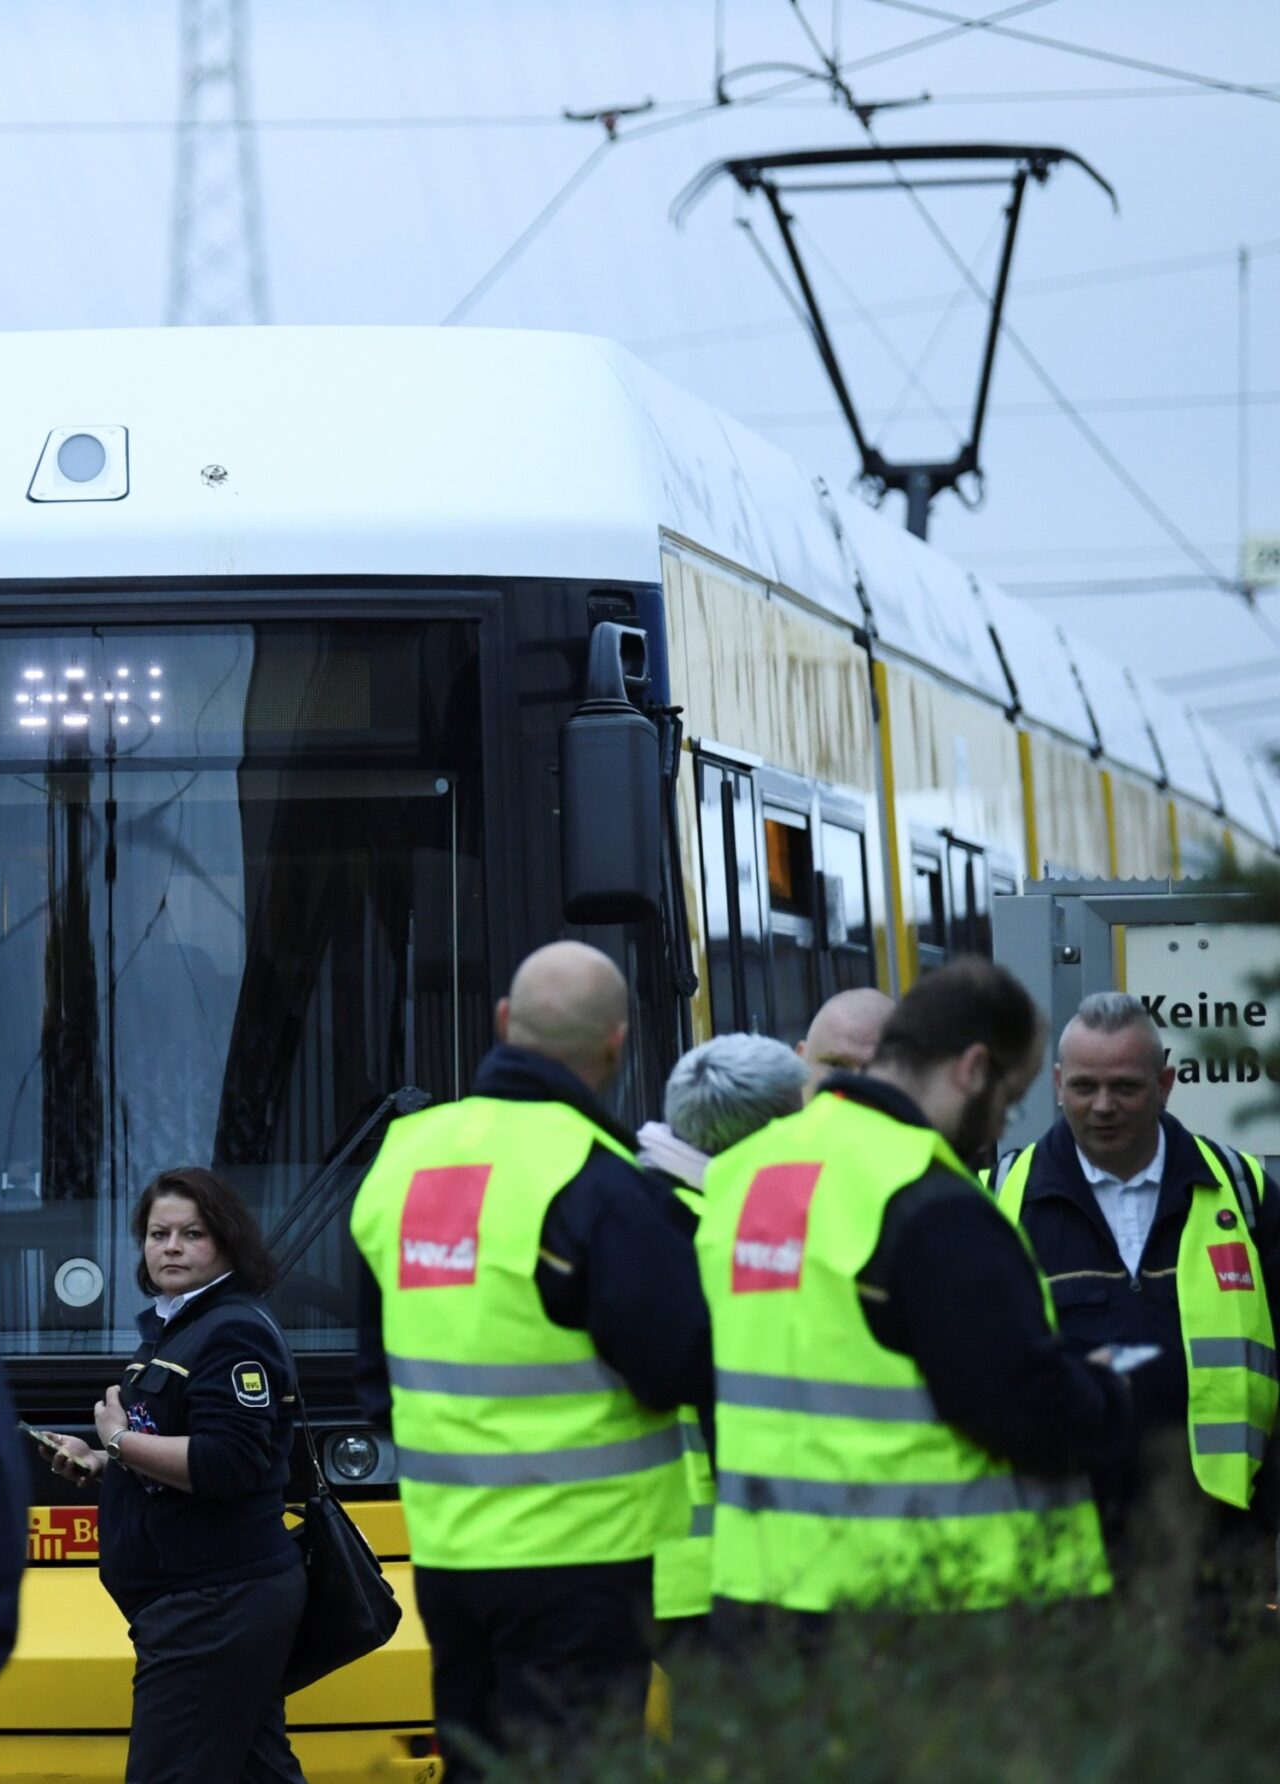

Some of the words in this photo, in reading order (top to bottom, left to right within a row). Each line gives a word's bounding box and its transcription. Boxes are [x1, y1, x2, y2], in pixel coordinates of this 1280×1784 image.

[1141, 992, 1267, 1028] Keine
[403, 1237, 475, 1270] ver.di
[735, 1239, 803, 1273] ver.di
